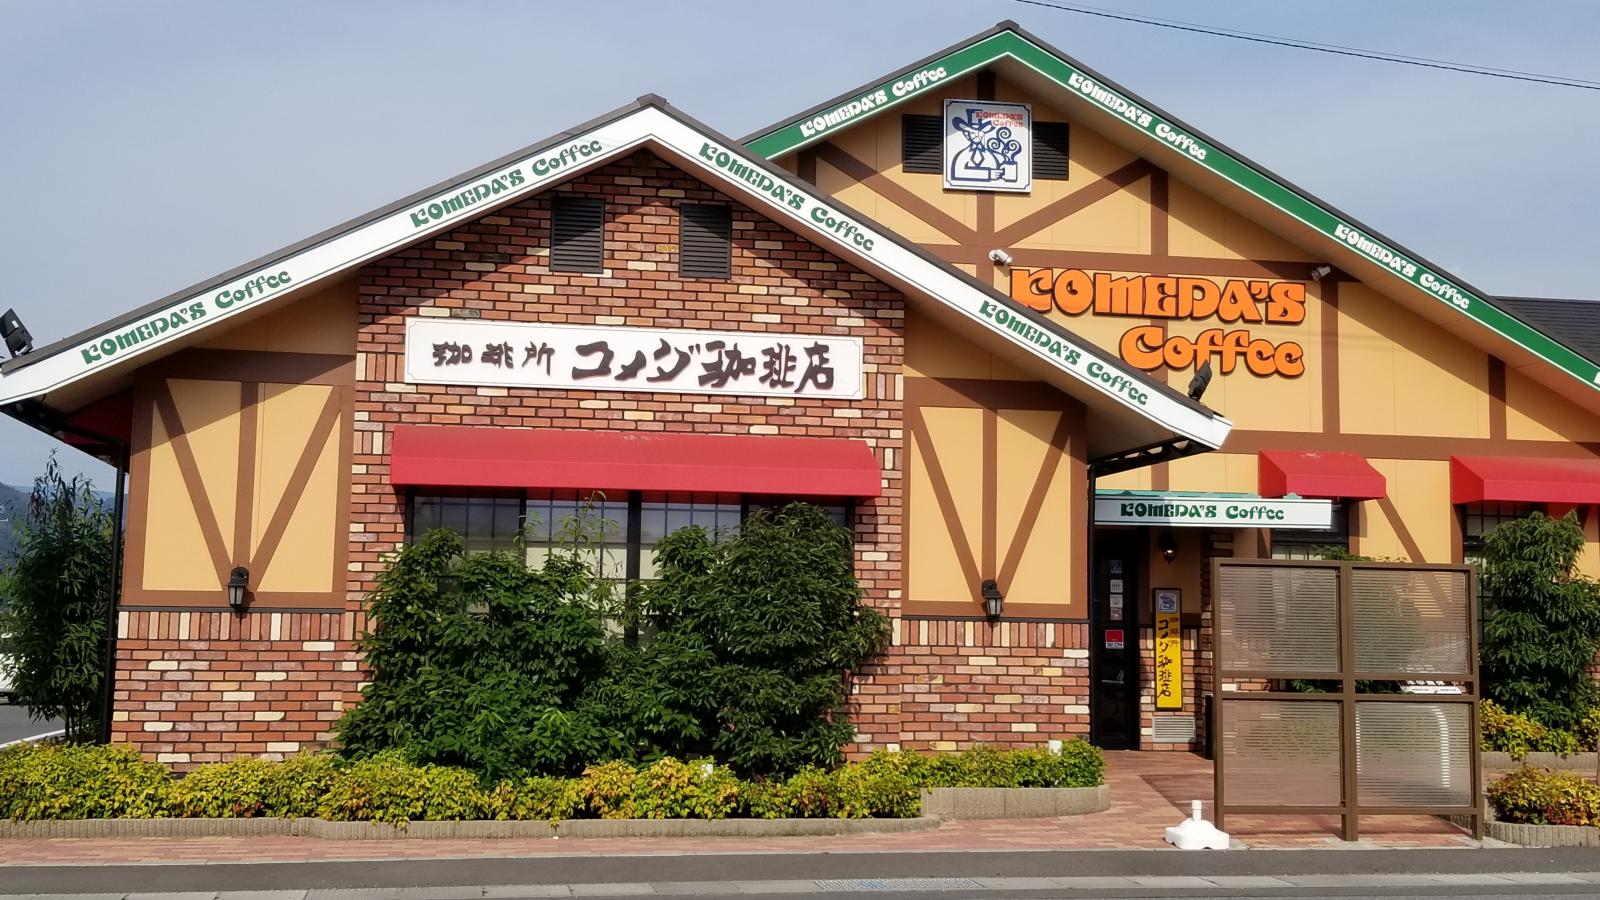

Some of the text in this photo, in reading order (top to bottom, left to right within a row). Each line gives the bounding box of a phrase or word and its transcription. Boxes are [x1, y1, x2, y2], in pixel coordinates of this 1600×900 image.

[799, 66, 948, 138] KOMEDA'S Coffee
[1067, 72, 1207, 160] KOMEDA'S Coffee
[411, 138, 603, 229] KOMEDA'S Coffee
[698, 141, 875, 253] KOMEDA'S Coffee
[1334, 223, 1470, 309] KOMEDA'S Coffee
[81, 269, 292, 365] KOMEDA'S Coffee
[977, 299, 1149, 406] KOMEDA'S Coffee
[1009, 268, 1307, 377] KOMEDA'S Coffee
[570, 336, 836, 394] コメダ珈琲店
[1120, 502, 1285, 521] KOMEDA'S Coffee
